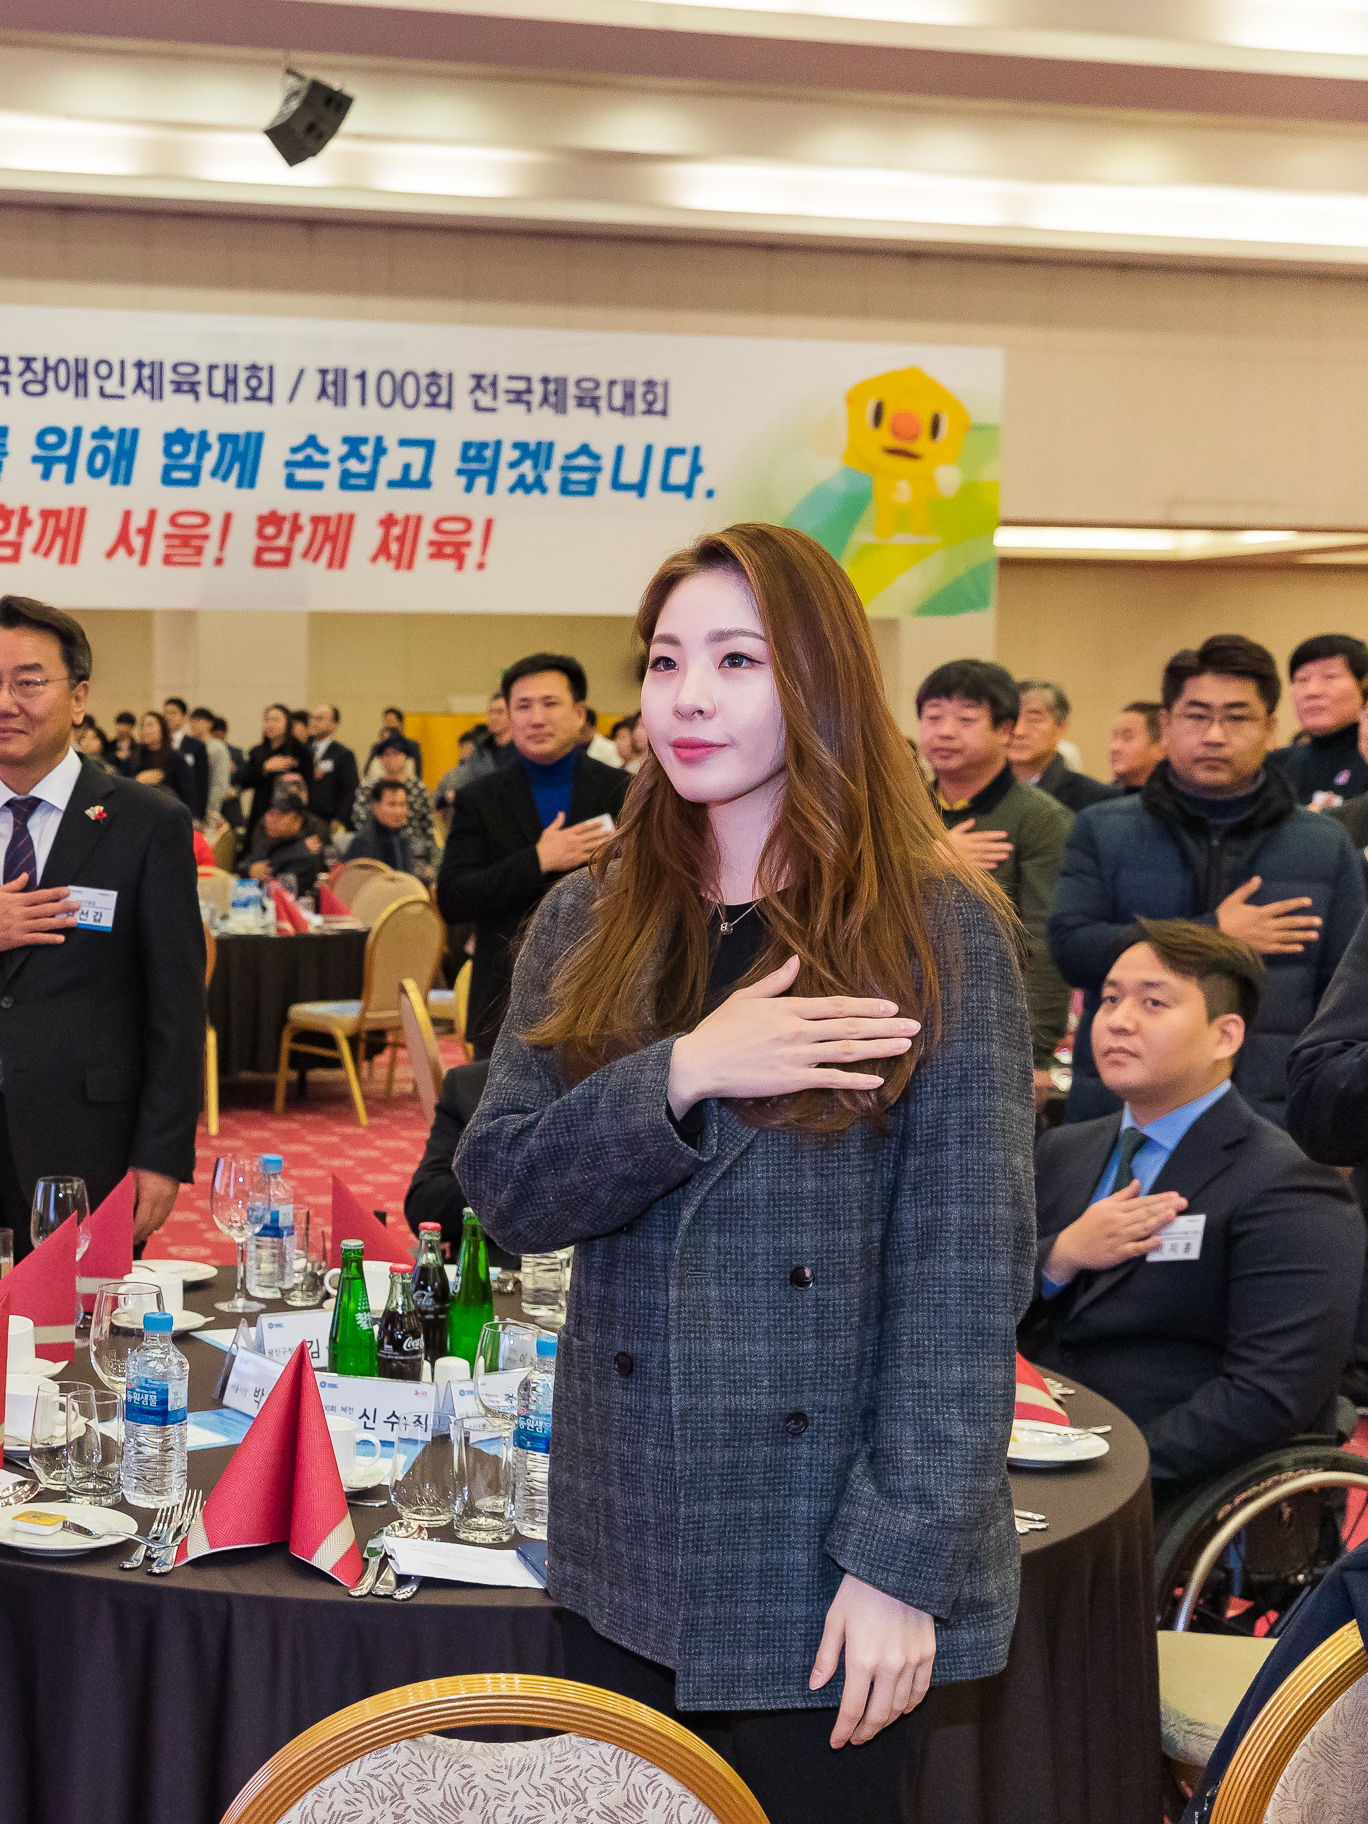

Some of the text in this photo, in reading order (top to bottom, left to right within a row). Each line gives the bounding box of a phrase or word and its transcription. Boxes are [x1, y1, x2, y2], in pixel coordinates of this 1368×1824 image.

[288, 368, 305, 404] /
[317, 367, 454, 412] 제100회
[469, 374, 670, 419] 전국체육대회
[31, 425, 141, 487] 위해
[161, 428, 266, 491] 함께
[284, 433, 437, 493] 손잡고
[456, 439, 716, 500] 뛰겠습니다.
[104, 508, 234, 569] 서울!
[253, 509, 357, 572] 함께
[369, 512, 496, 573] 체육!
